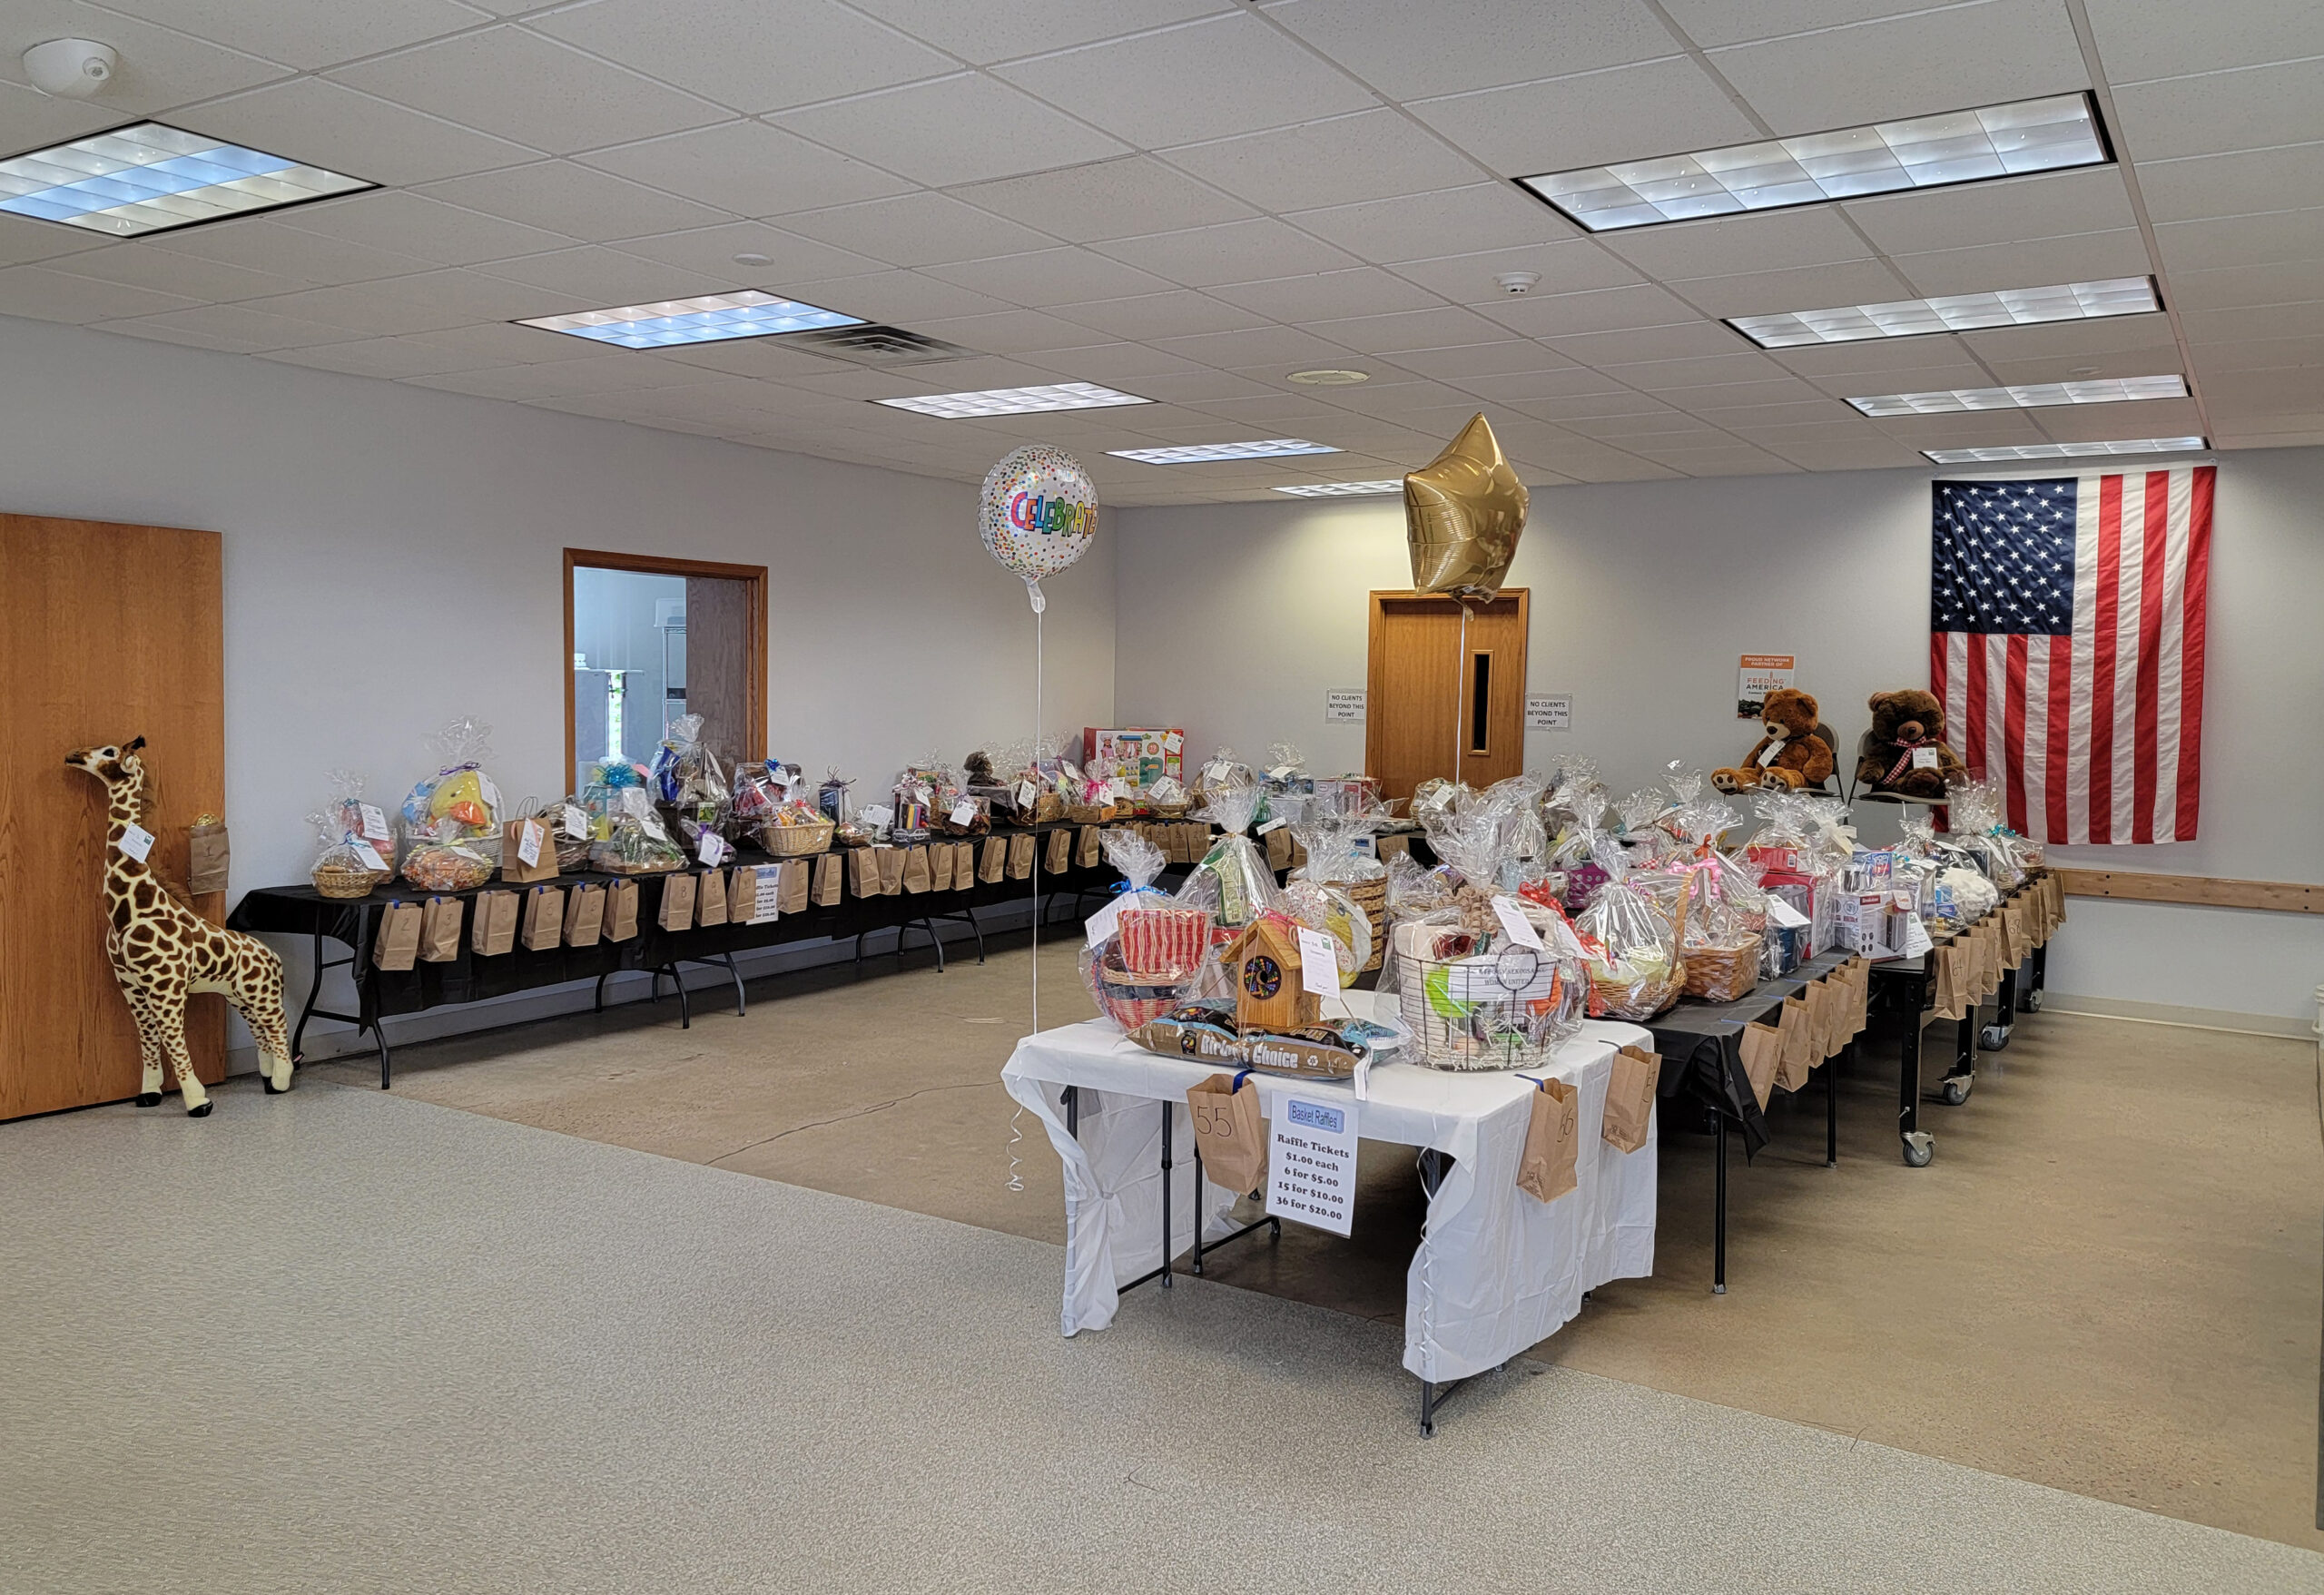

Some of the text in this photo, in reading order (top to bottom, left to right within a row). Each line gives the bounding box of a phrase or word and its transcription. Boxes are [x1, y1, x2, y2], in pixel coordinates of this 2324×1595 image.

[1010, 491, 1097, 538] CELEBRATE
[202, 846, 212, 858] 1
[401, 917, 410, 931] 2
[443, 913, 453, 926] 3
[2007, 918, 2022, 935] 68
[1952, 958, 1964, 977] 64
[1508, 978, 1531, 986] UNITED
[1252, 1045, 1298, 1068] Choice
[1197, 1106, 1231, 1137] 55
[1292, 1105, 1337, 1128] Basket Raffles
[1556, 1108, 1574, 1143] 56
[1277, 1133, 1350, 1158] Raffle Tickets
[1285, 1152, 1339, 1172] $1.00 each
[1285, 1167, 1339, 1186] 6 for $5.00
[1278, 1181, 1344, 1204] 15 for $10.00
[1275, 1196, 1343, 1220] 36 for $20.00
